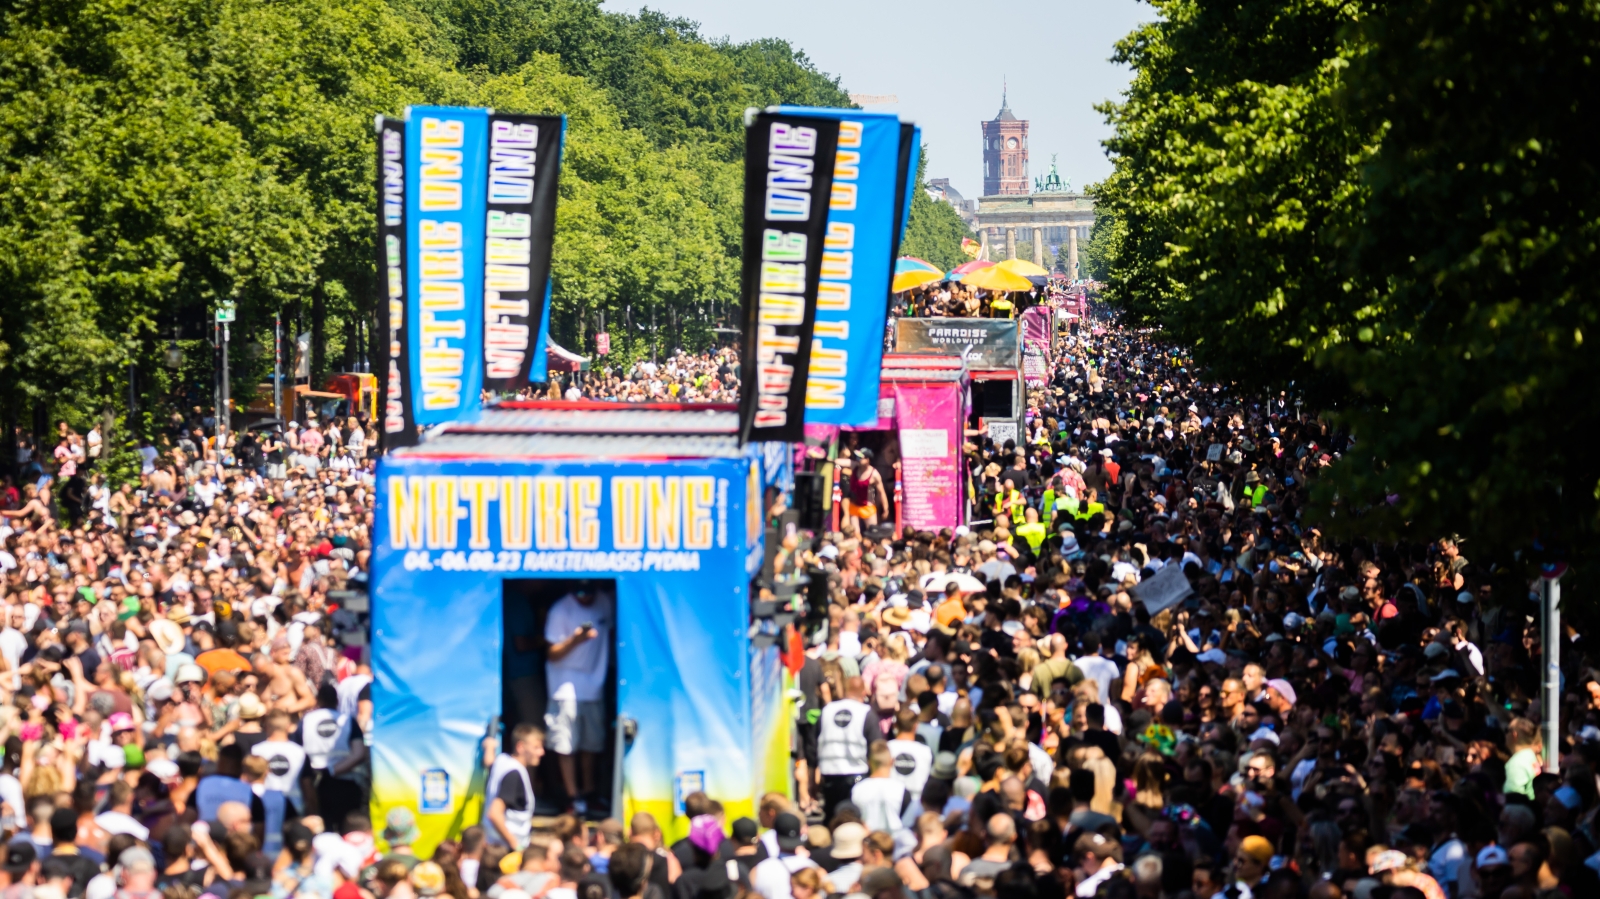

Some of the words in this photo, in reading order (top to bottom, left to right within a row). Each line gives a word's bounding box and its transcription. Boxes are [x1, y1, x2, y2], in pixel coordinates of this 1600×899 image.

[419, 117, 464, 212] ONE
[487, 119, 539, 204] ONE
[764, 121, 817, 222] ONE
[419, 219, 465, 411] NATURE
[484, 210, 532, 379] NATURE
[753, 228, 808, 428] NATURE
[928, 328, 988, 338] PARADISE
[932, 337, 985, 345] WORLDWIDE
[388, 475, 603, 551] NATURE
[610, 475, 716, 551] ONE
[642, 551, 701, 572] PYDNA
